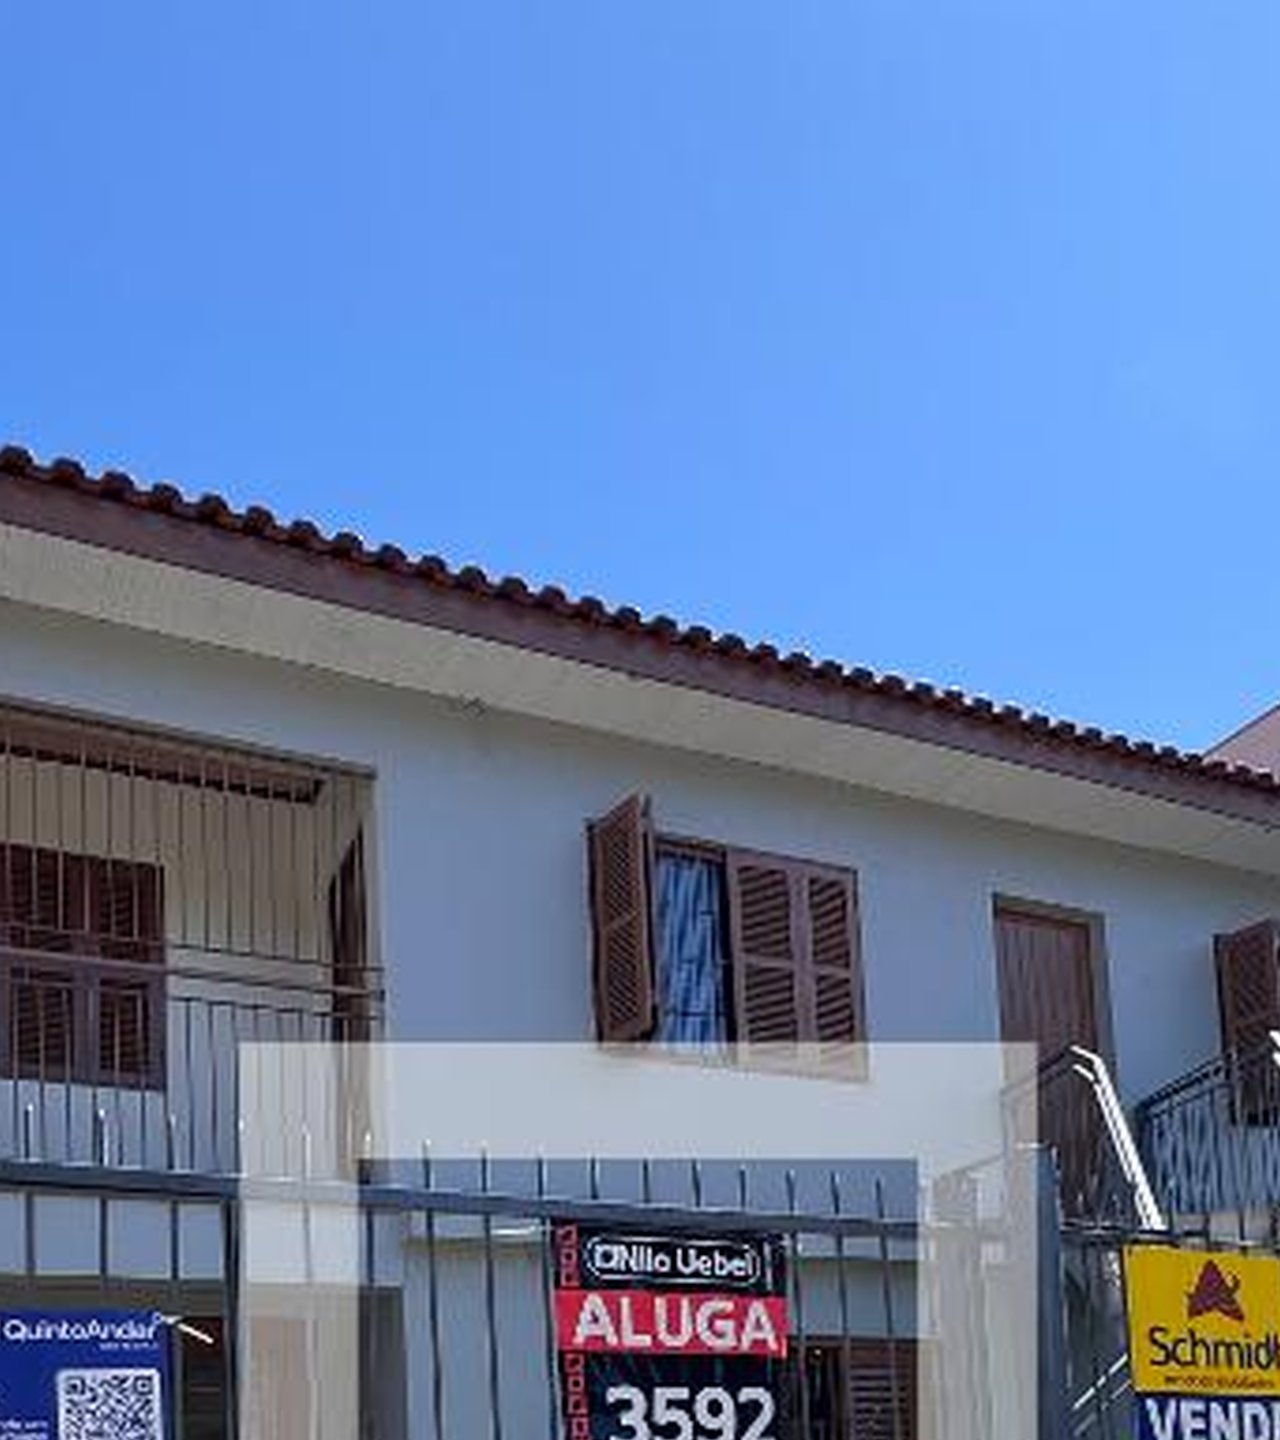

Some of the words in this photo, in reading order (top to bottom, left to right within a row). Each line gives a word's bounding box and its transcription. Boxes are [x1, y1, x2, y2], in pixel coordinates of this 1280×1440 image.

[620, 1243, 671, 1273] Nilo
[3, 1317, 157, 1342] QuintoAndar
[572, 1291, 779, 1351] ALUGA
